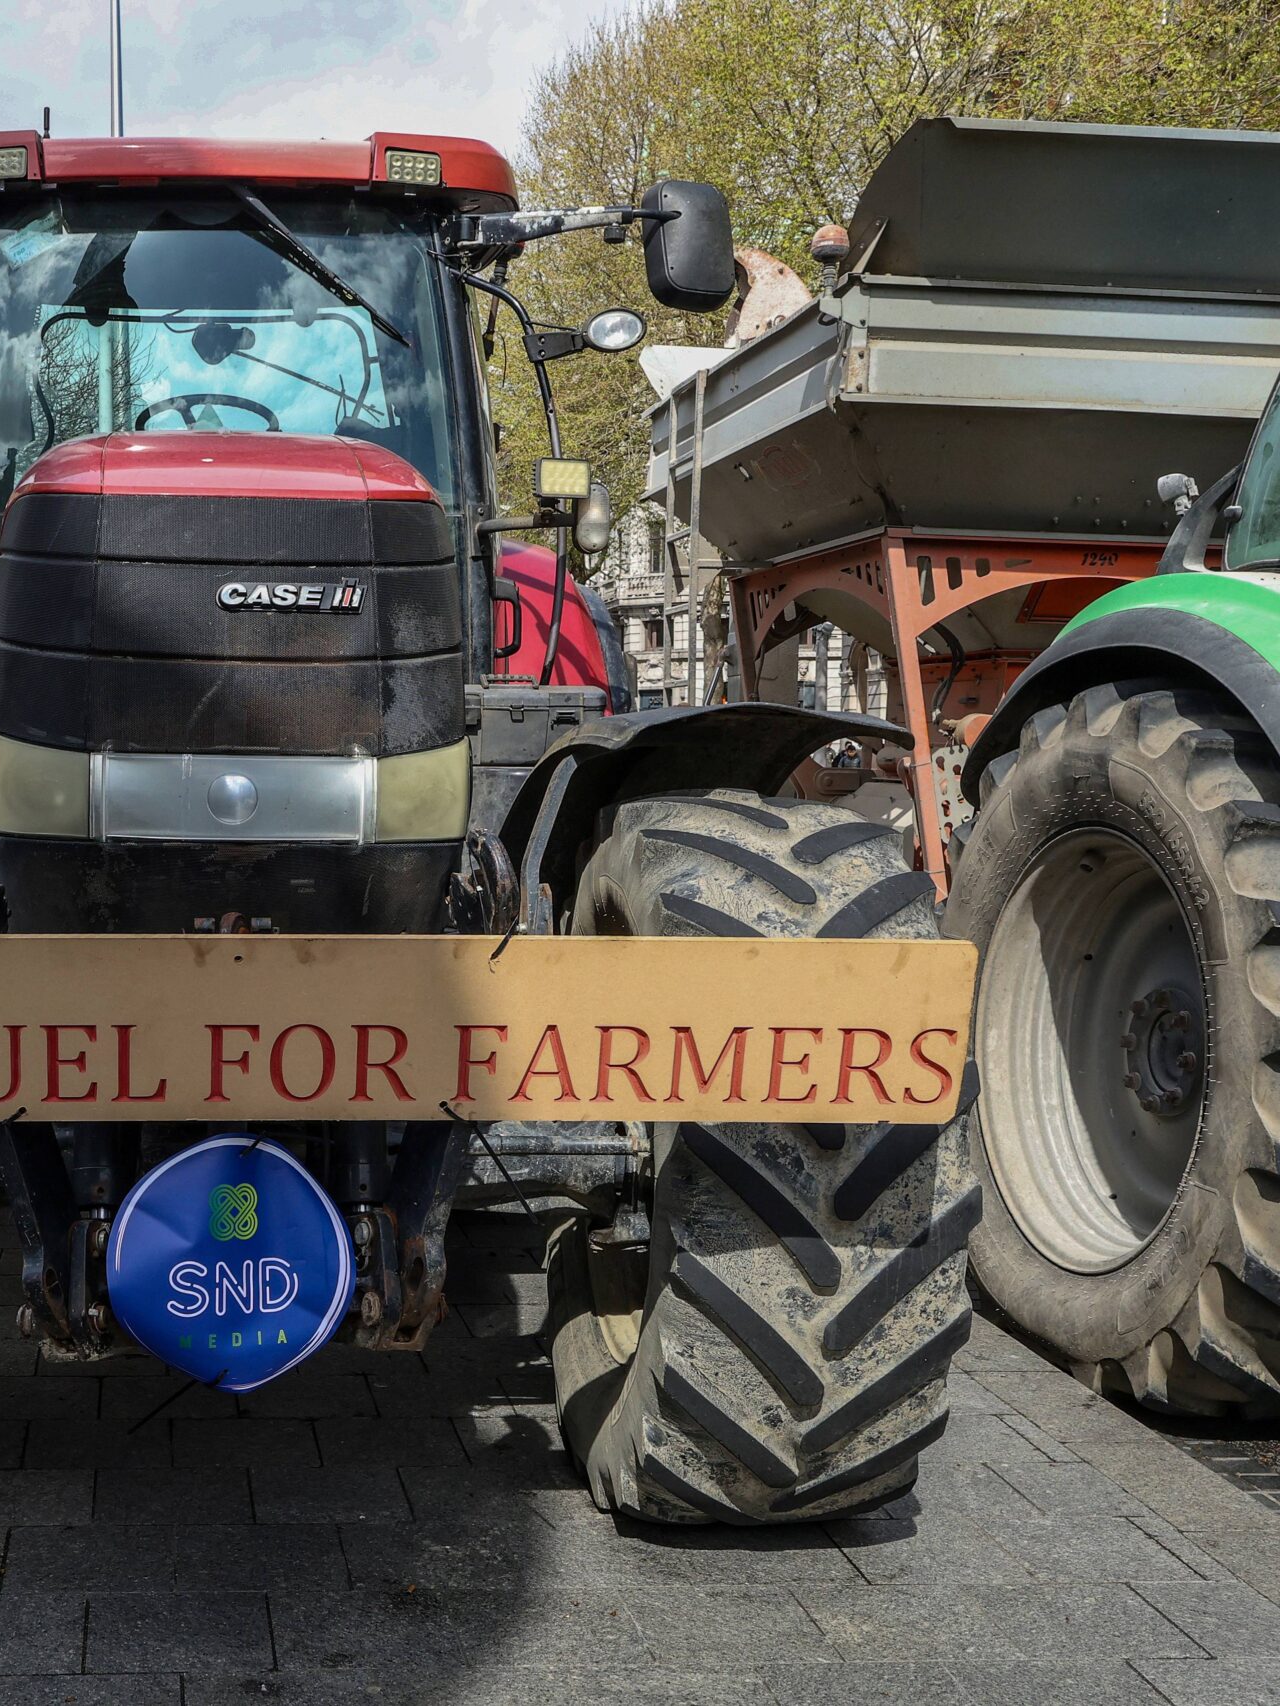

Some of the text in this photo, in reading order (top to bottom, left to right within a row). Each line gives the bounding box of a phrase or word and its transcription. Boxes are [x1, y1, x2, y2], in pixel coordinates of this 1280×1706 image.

[220, 583, 323, 606] CASE
[204, 1024, 417, 1102] FOR
[449, 1025, 960, 1105] FARMERS
[166, 1257, 299, 1318] SND
[179, 1329, 288, 1349] MEDIA
